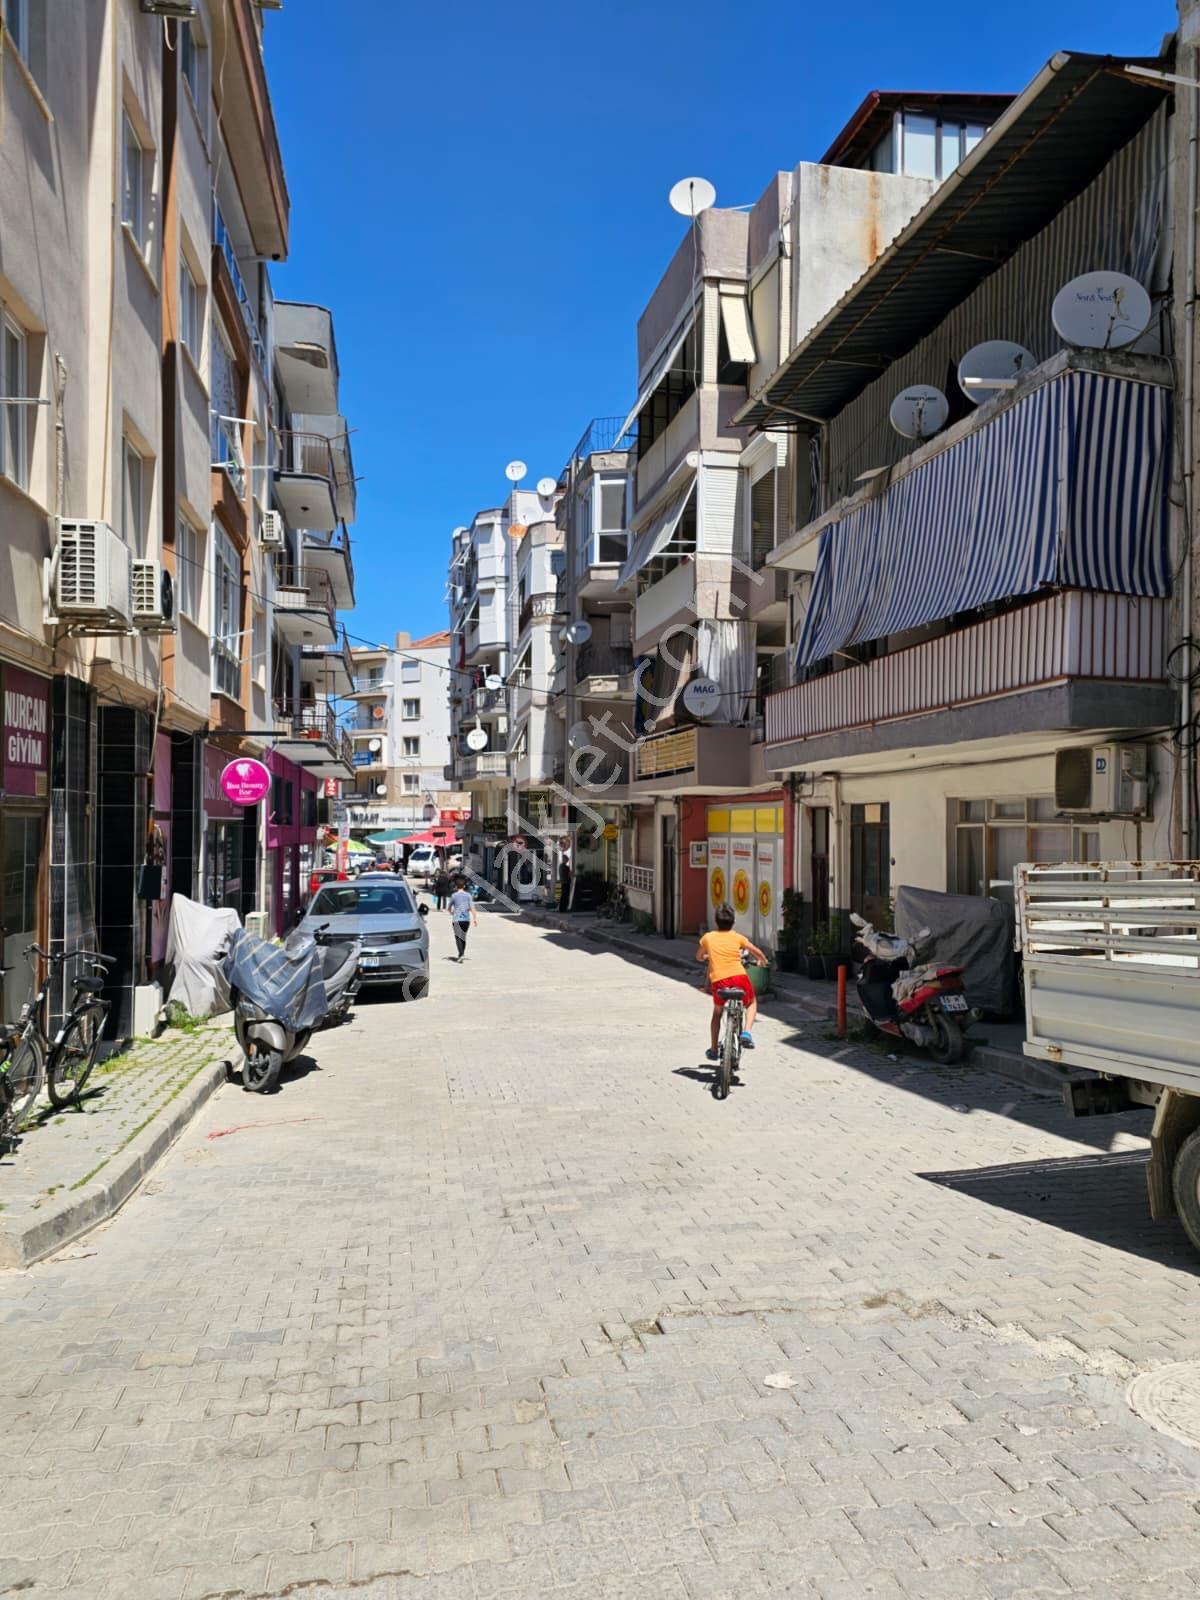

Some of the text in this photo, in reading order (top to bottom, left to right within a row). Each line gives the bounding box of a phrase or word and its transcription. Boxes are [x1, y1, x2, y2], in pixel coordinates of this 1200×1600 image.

[693, 685, 716, 694] MAG
[4, 690, 47, 733] NURCAN
[8, 731, 42, 765] GİYİM
